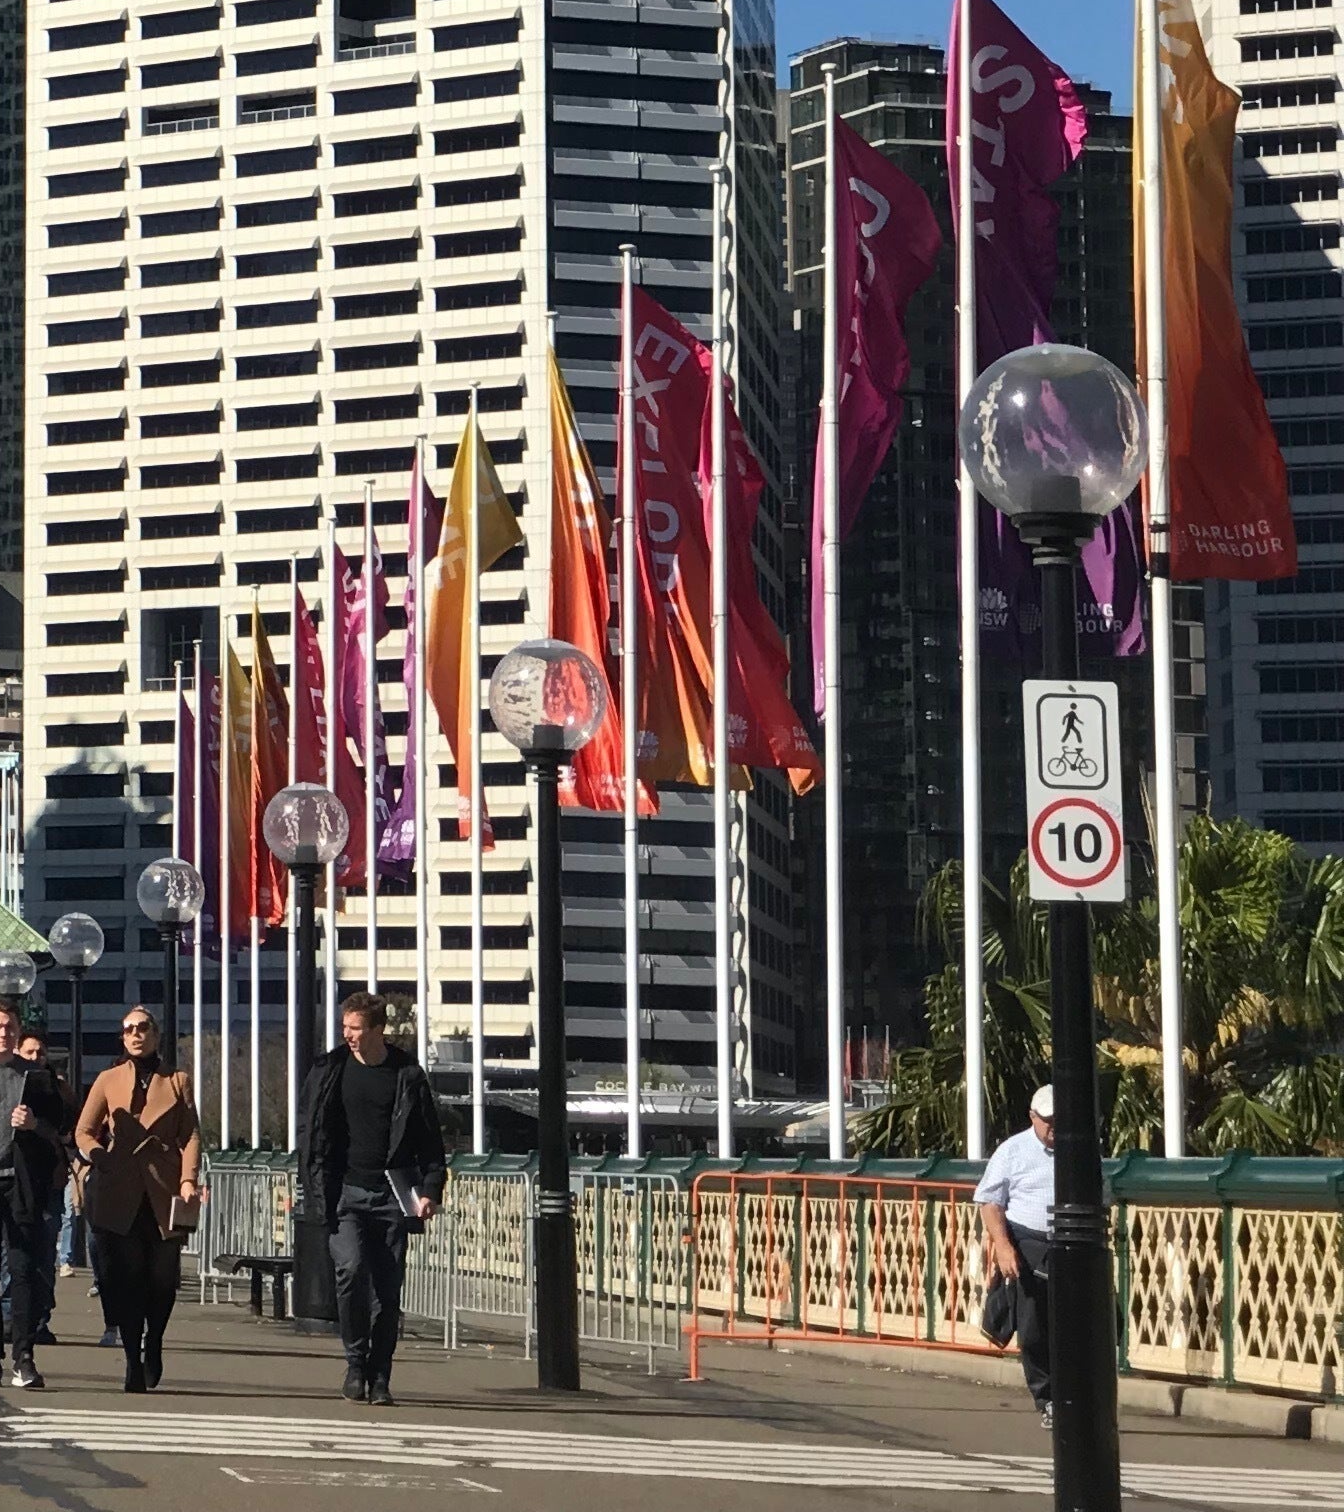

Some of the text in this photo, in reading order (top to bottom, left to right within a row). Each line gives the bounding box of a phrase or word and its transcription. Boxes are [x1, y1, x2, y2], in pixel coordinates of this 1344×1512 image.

[1188, 519, 1271, 539] DARLING
[1195, 537, 1285, 558] HARBOUR
[1047, 822, 1102, 863] 10
[659, 1082, 686, 1093] BAY
